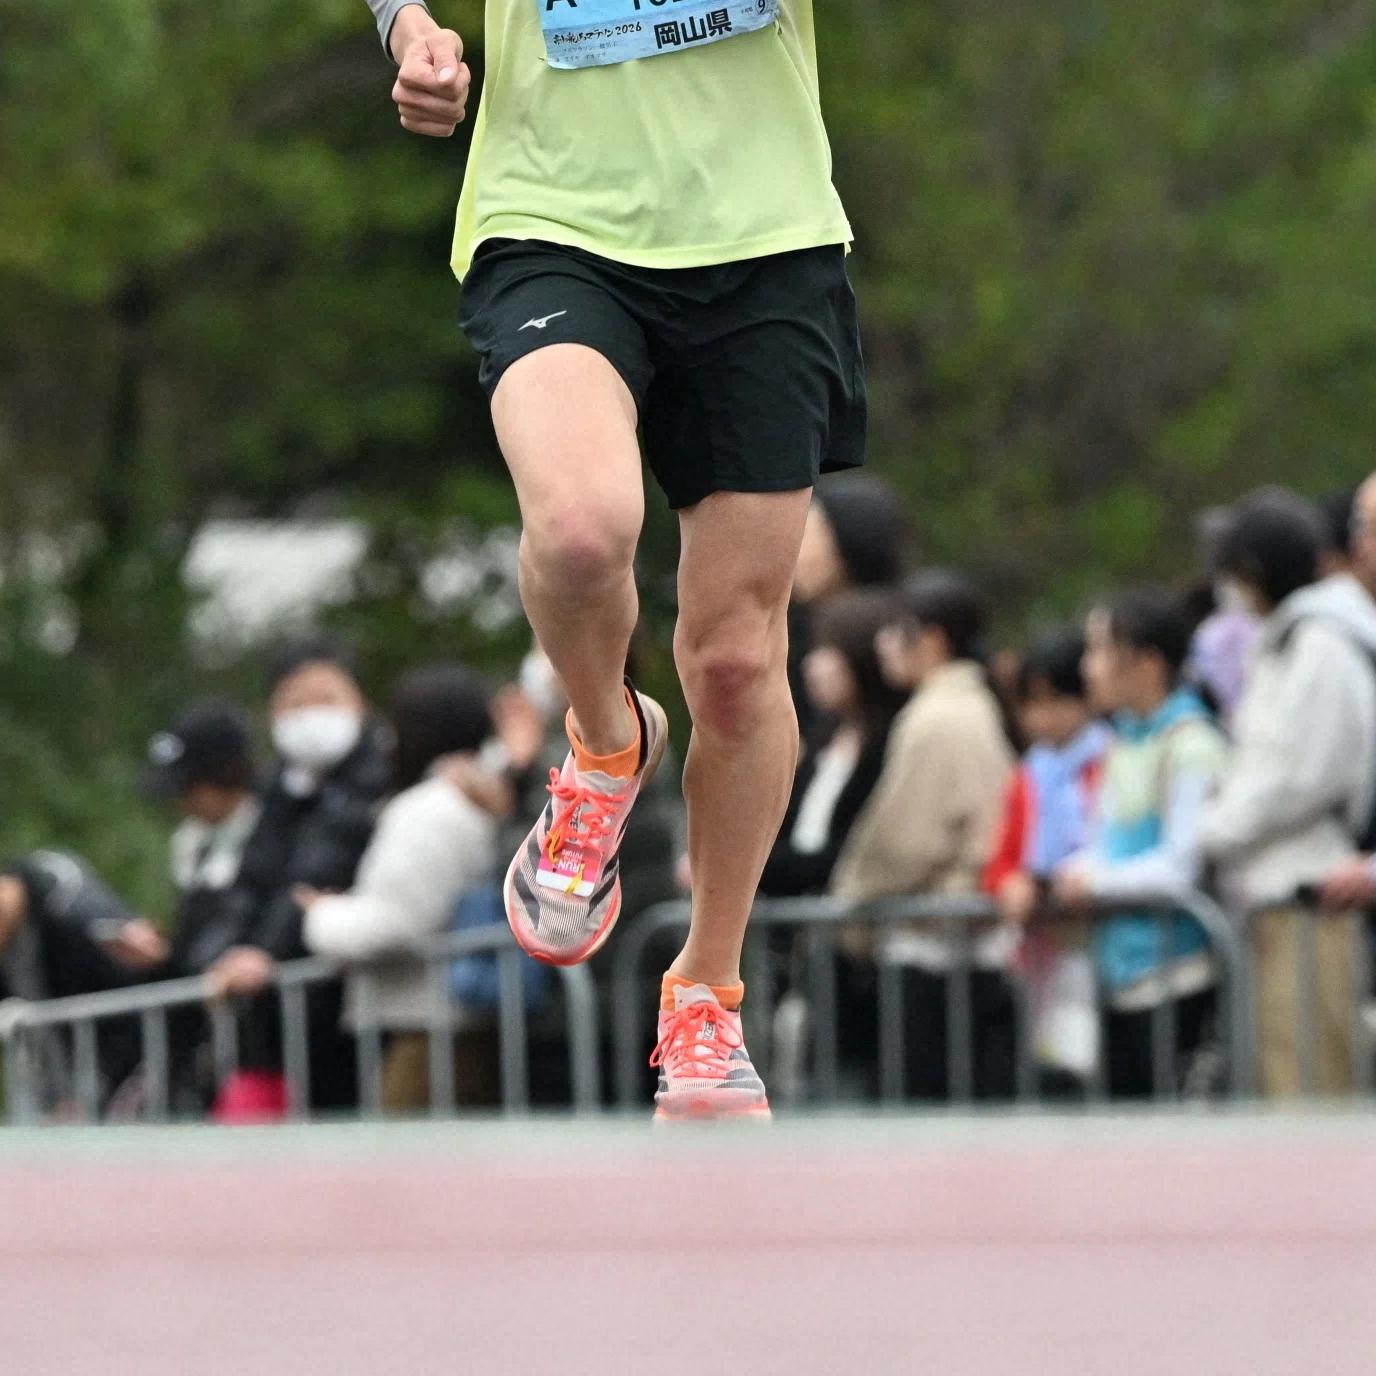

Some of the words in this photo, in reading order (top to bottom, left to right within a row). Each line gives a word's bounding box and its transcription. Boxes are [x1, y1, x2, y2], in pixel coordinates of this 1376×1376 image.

[653, 8, 733, 49] 岡山県
[558, 859, 580, 873] RUN
